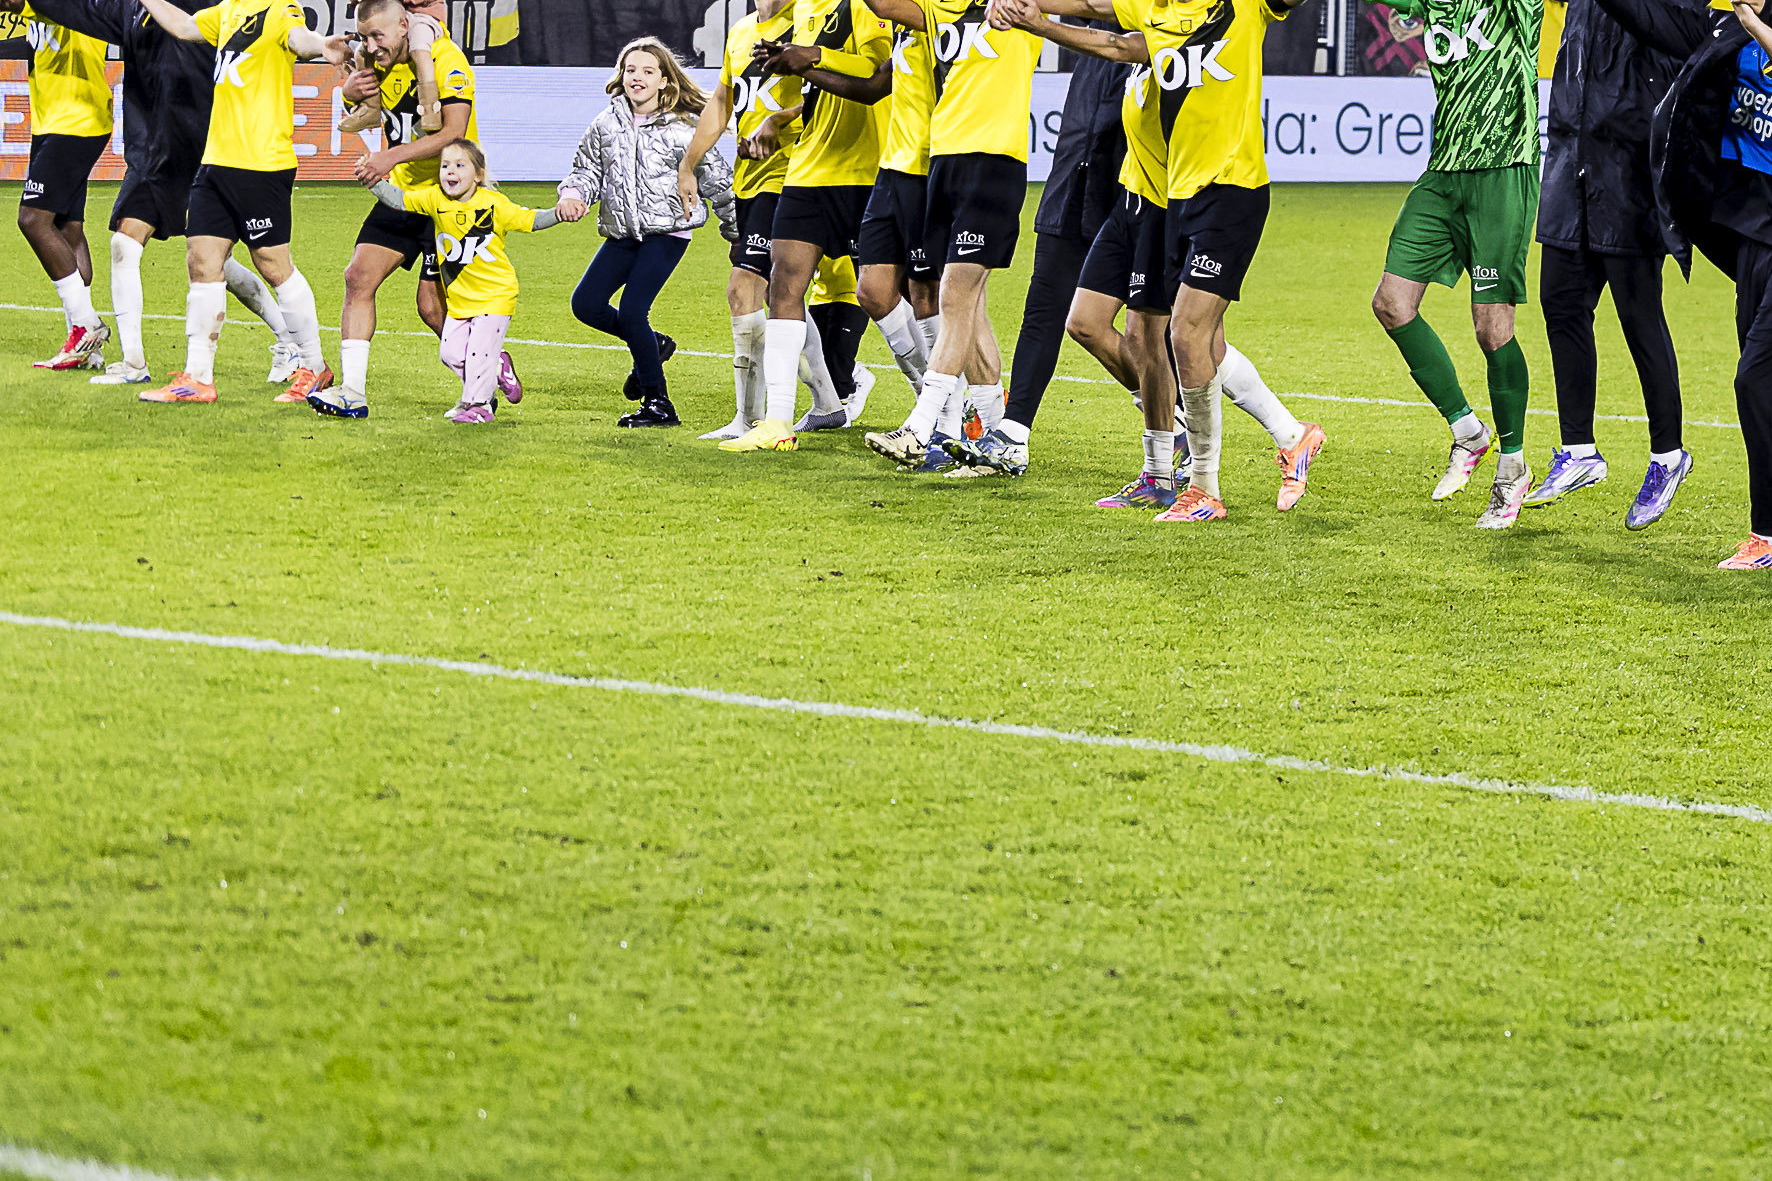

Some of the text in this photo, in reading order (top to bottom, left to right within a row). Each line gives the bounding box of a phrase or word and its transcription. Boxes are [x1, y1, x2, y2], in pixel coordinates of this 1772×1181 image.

[934, 22, 1000, 62] OK
[1424, 5, 1495, 65] OK
[1154, 38, 1236, 91] OK
[1335, 101, 1433, 156] Gre
[437, 232, 497, 265] OK
